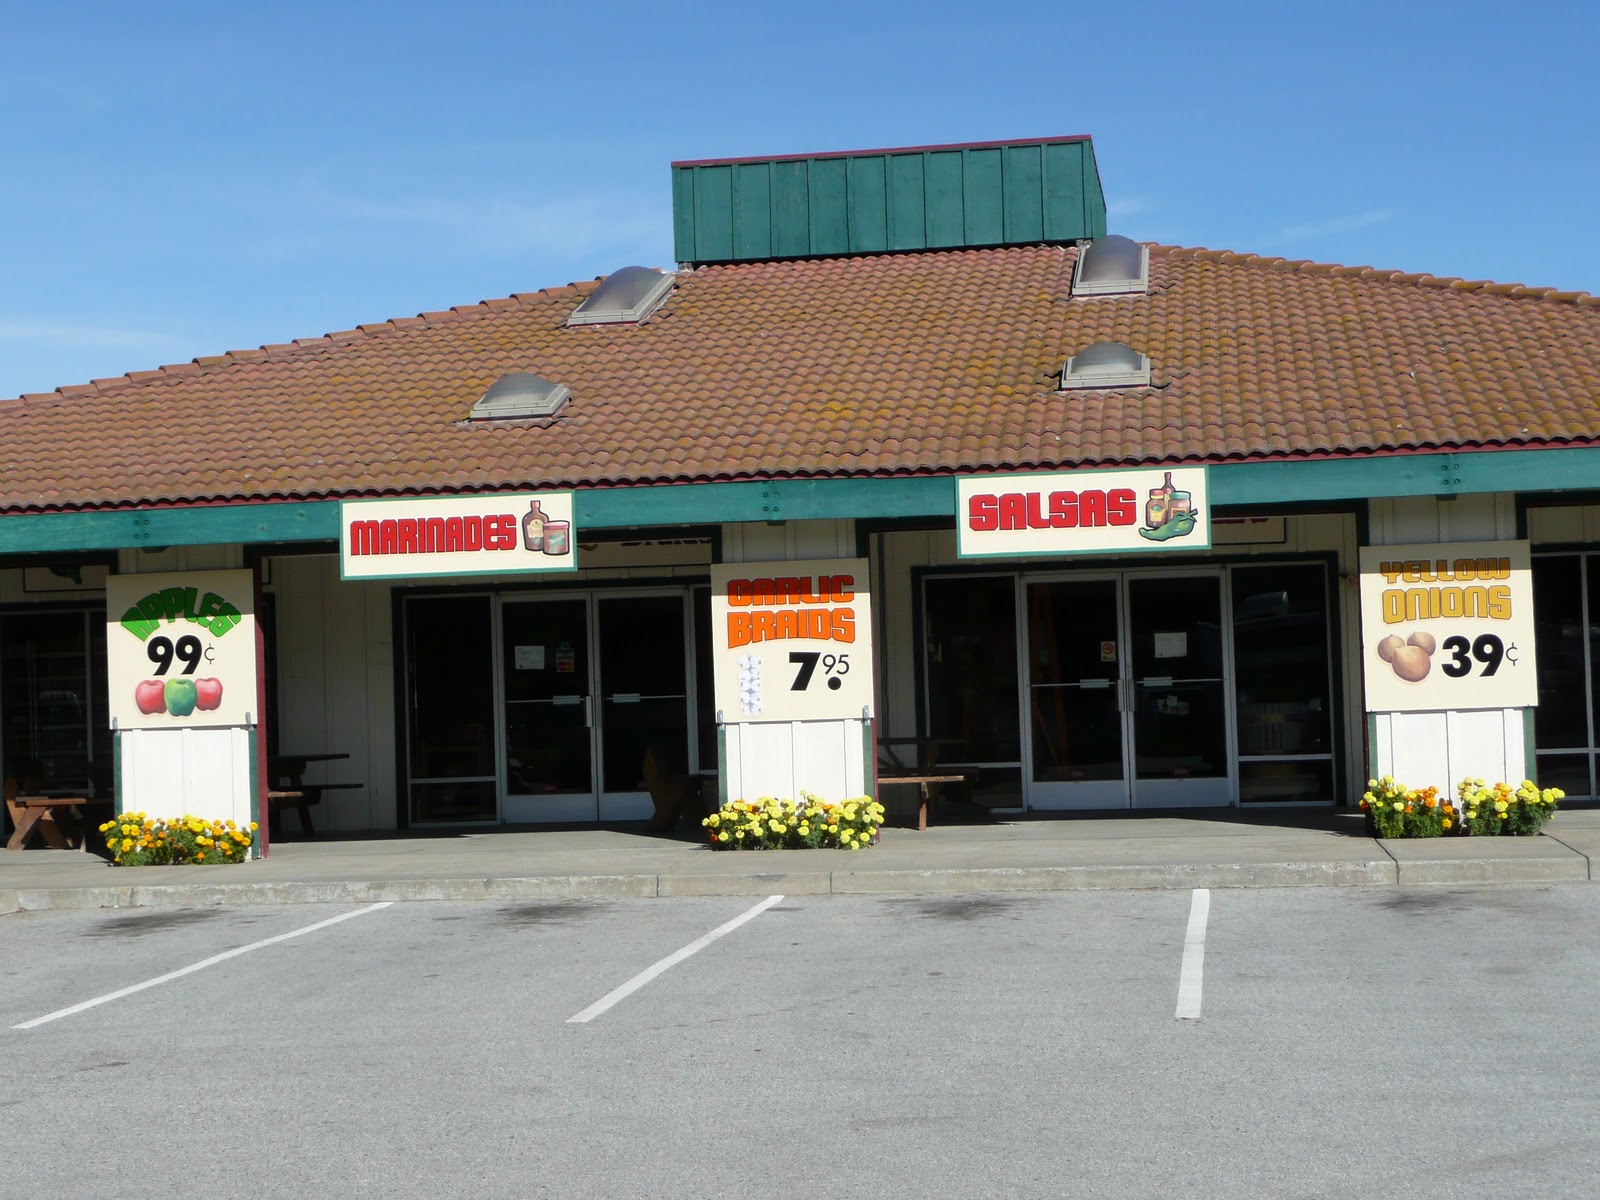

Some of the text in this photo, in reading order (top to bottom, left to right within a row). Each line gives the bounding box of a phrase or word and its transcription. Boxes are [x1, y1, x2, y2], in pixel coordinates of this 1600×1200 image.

[969, 488, 1136, 531] SALSAS
[350, 514, 517, 556] MARINADES
[727, 575, 854, 607] GARLIC
[1380, 557, 1511, 584] YELLOW
[120, 587, 242, 642] APPLES
[1382, 585, 1512, 624] ONIONS
[727, 607, 855, 649] BRAIDS
